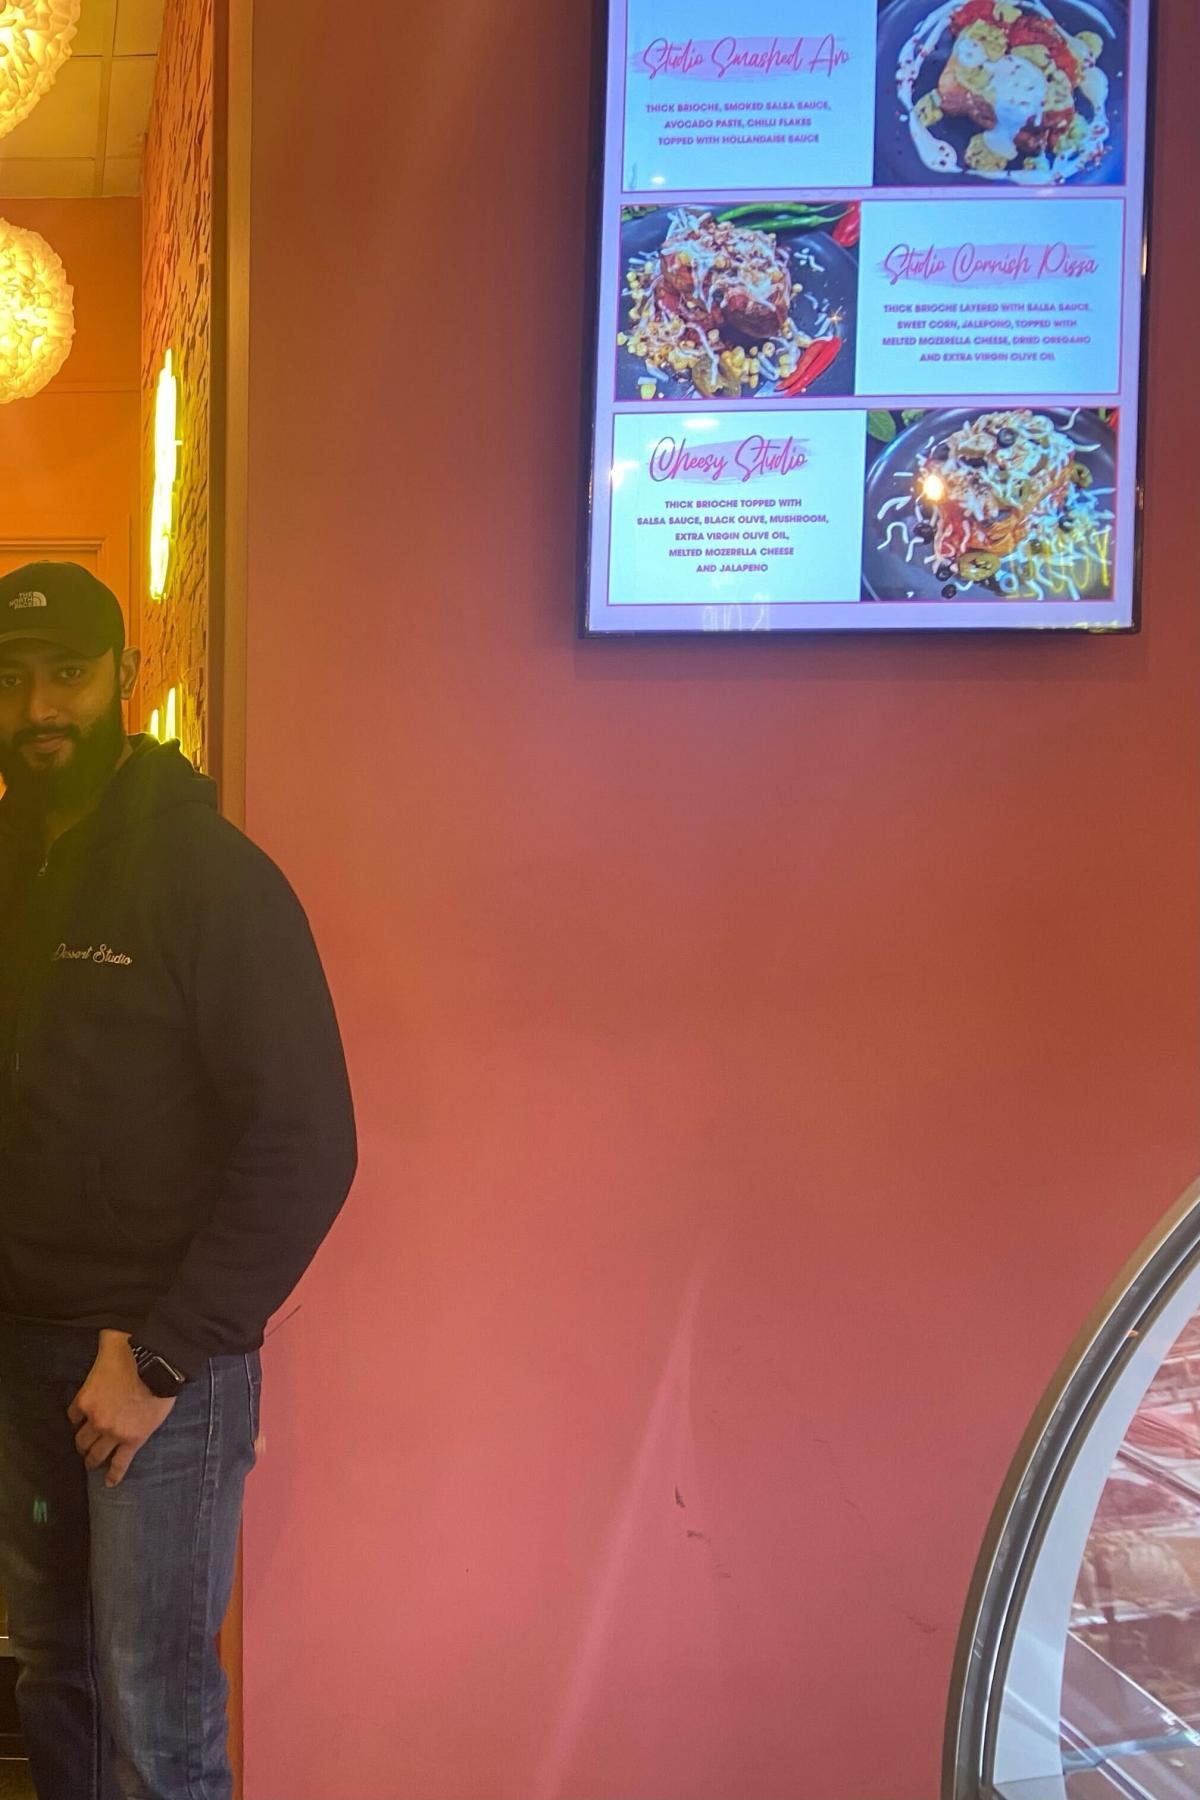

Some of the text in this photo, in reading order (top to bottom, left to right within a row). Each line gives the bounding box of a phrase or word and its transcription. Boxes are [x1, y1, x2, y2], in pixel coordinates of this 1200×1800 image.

[643, 33, 849, 79] Studio Smashed Avo
[646, 101, 831, 112] THICK BRIOCHE, SMOKED SALSA SAUCE,
[664, 120, 714, 129] AVOCADO
[747, 118, 776, 127] CHILLI
[779, 118, 812, 126] FLAKES
[658, 134, 819, 146] TOPPED WITH HOLLANDAISE SAUCE
[884, 243, 945, 285] Studio
[952, 242, 1031, 283] Cornish
[883, 304, 913, 313] THICK
[915, 303, 957, 312] BRIOCHE
[960, 303, 999, 312] LAYERED
[1001, 303, 1025, 312] WITH
[1027, 303, 1056, 312] SALSA
[897, 320, 926, 329] SWEET
[1015, 319, 1051, 328] TOPPED
[1053, 319, 1077, 328] WITH
[882, 336, 917, 345] MELTED
[1012, 336, 1040, 345] DRIED
[1042, 335, 1092, 344] OREGANO
[920, 352, 1056, 362] AND EXTRA VIRGIN OLIVE OIL
[650, 435, 808, 482] Cheesy Studio
[665, 498, 802, 509] THICK BRIOCHE TOPPED WITH
[637, 514, 829, 526] SALSA SAUCE, BLACK OLIVE, MUSHROOM,
[675, 531, 790, 541] EXTRA VIRGIN OLIVE OIL,
[668, 547, 794, 557] MELTED MOZERELLA CHEESE
[696, 563, 769, 573] AND JALAPENO
[9, 597, 33, 607] NORTH
[93, 943, 133, 965] Studio
